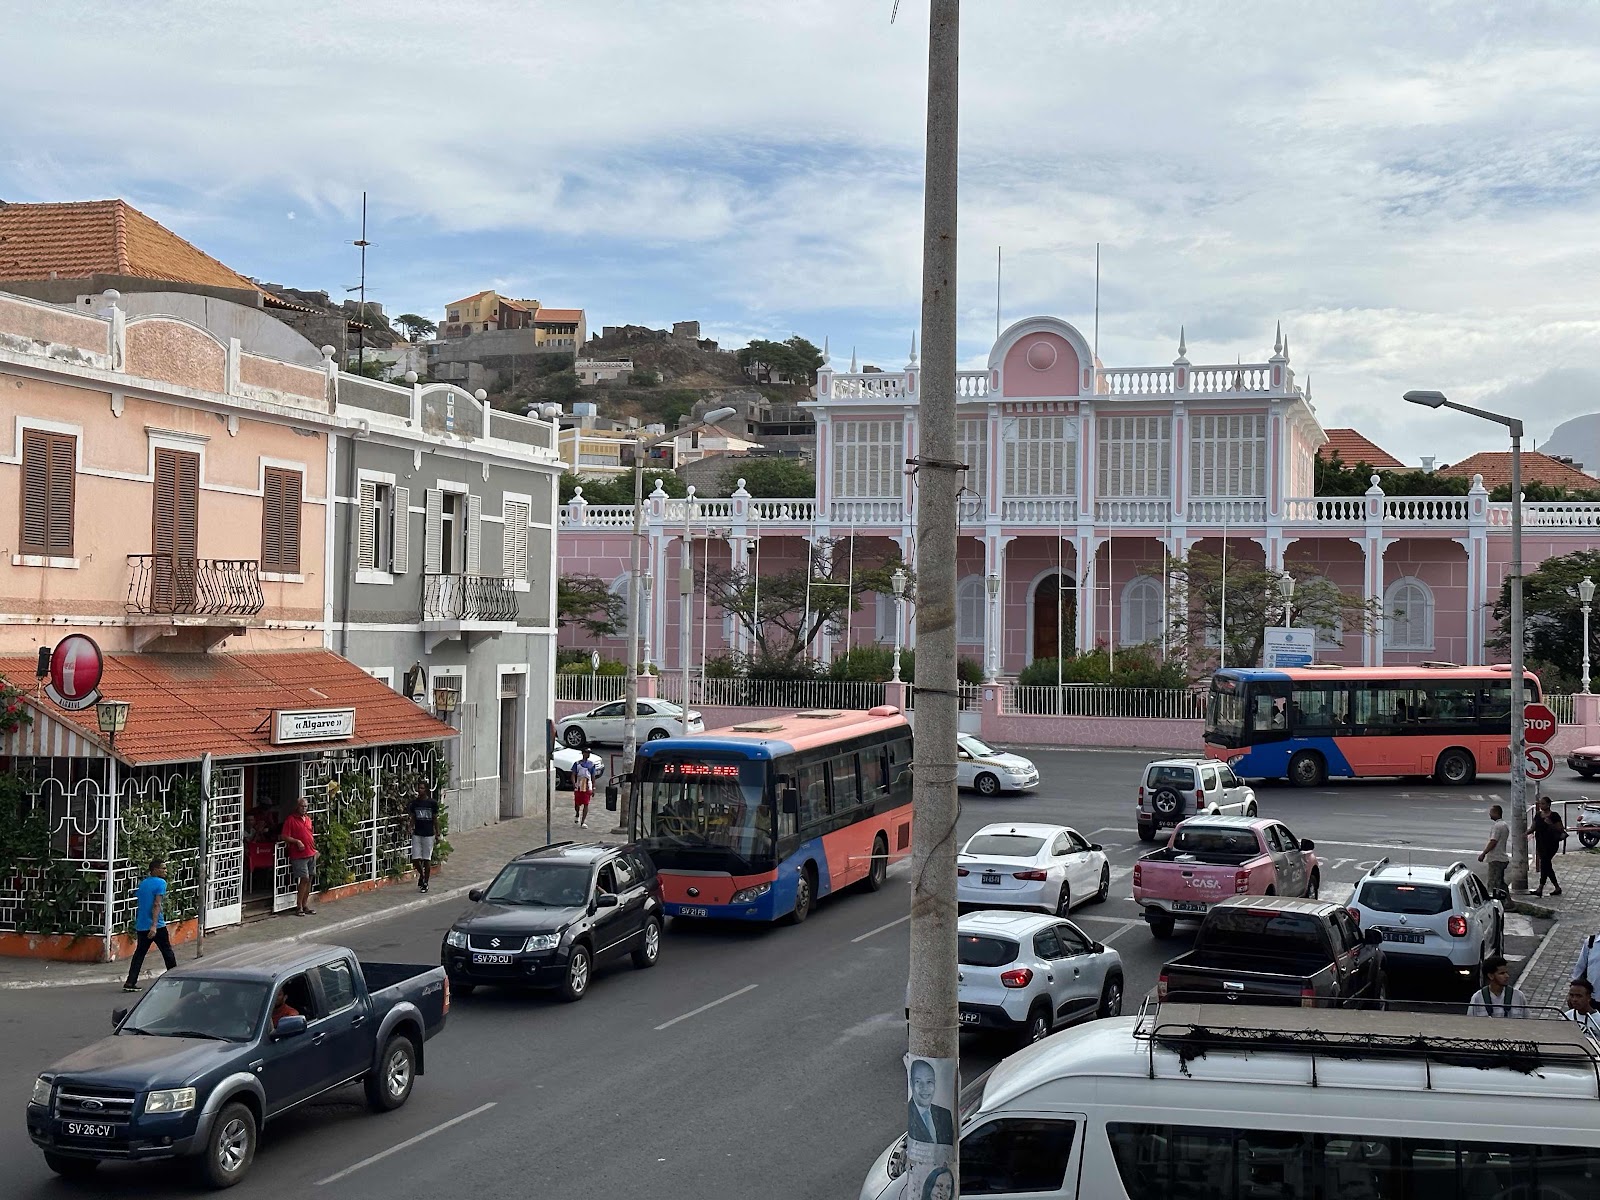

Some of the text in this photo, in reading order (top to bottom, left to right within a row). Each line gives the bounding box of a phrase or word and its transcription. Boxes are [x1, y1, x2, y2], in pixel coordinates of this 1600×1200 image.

[302, 720, 335, 730] Algarve
[1524, 718, 1551, 731] STOP
[1192, 879, 1222, 889] CASA
